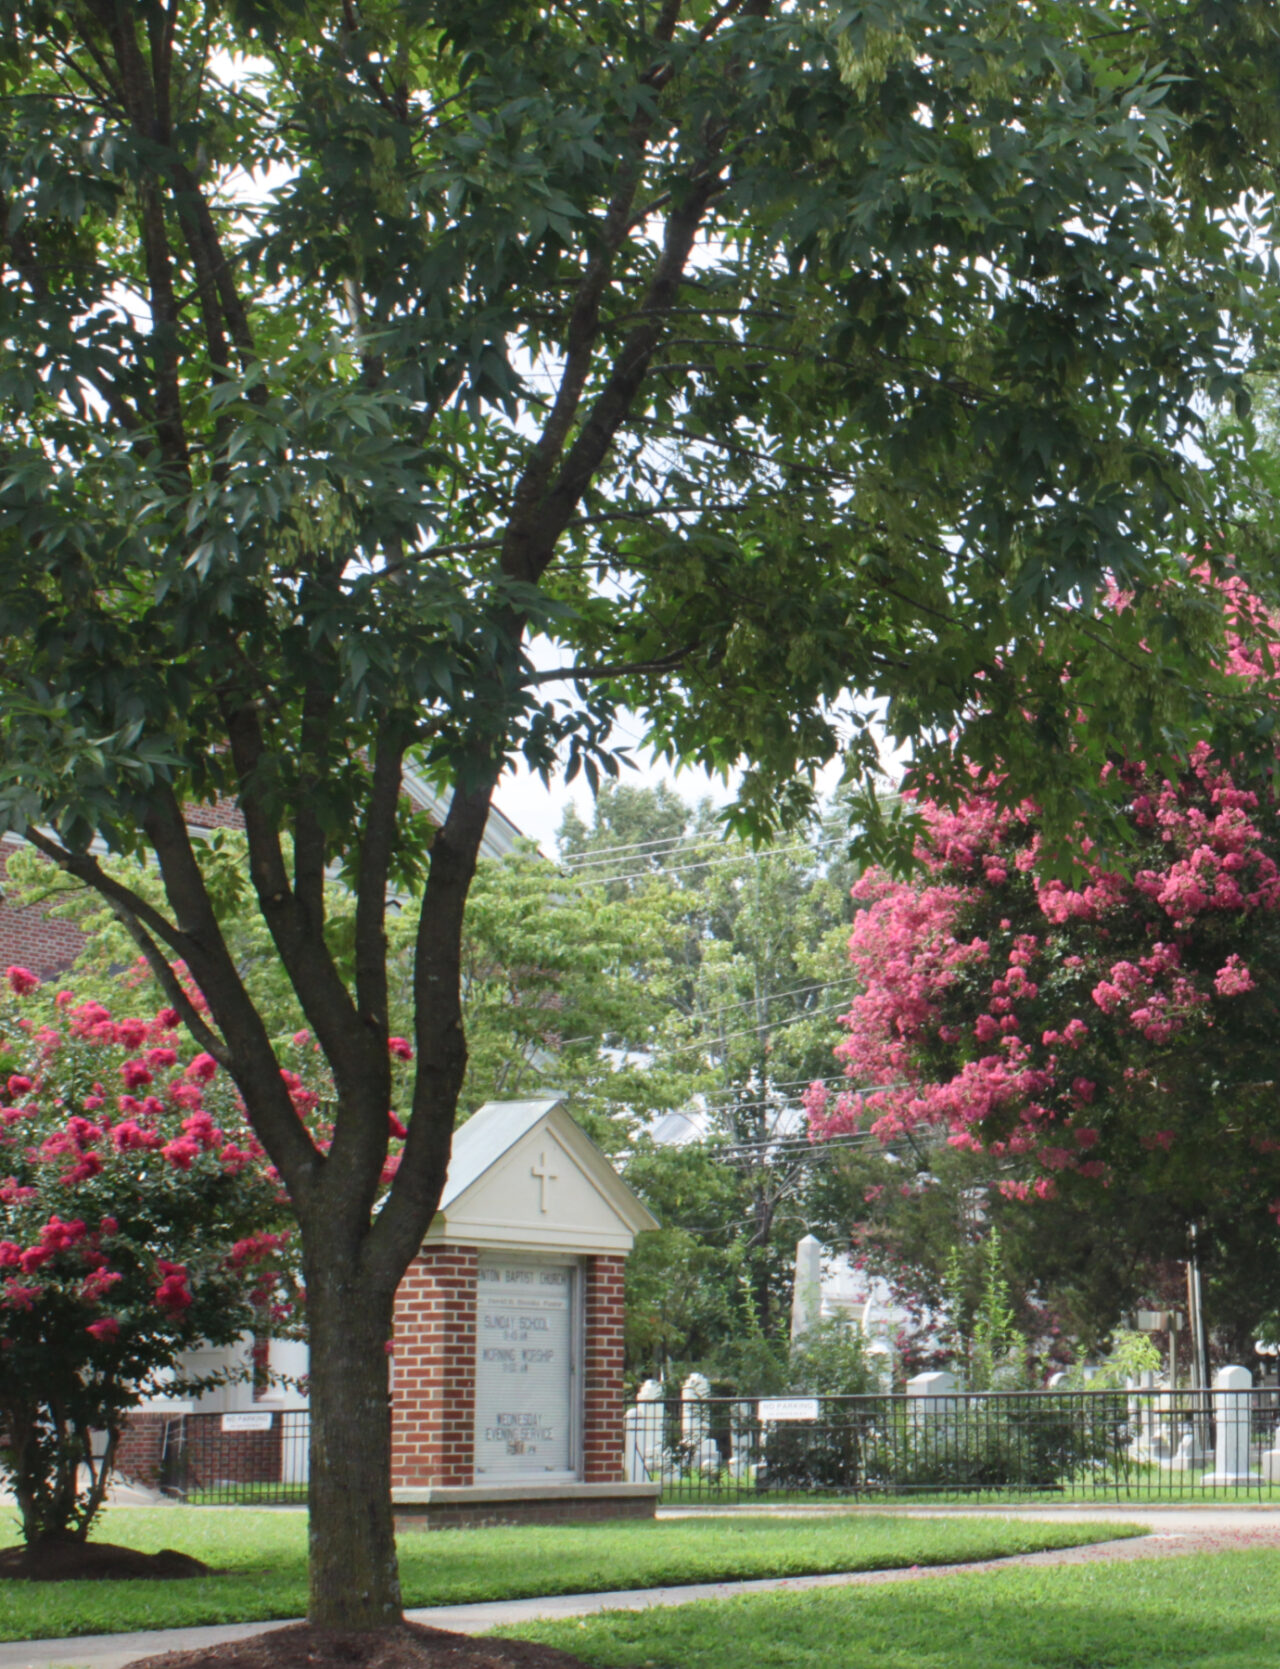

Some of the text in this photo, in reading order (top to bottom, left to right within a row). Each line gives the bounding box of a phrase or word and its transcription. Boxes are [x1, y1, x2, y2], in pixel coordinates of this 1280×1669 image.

[505, 1269, 534, 1284] BAPTIST
[484, 1315, 550, 1331] SUNDAY SCHOOL
[483, 1348, 554, 1362] MORNING WORSHIP
[496, 1413, 542, 1426] WEDNESDAY
[486, 1427, 553, 1440] EVENING SERVICE
